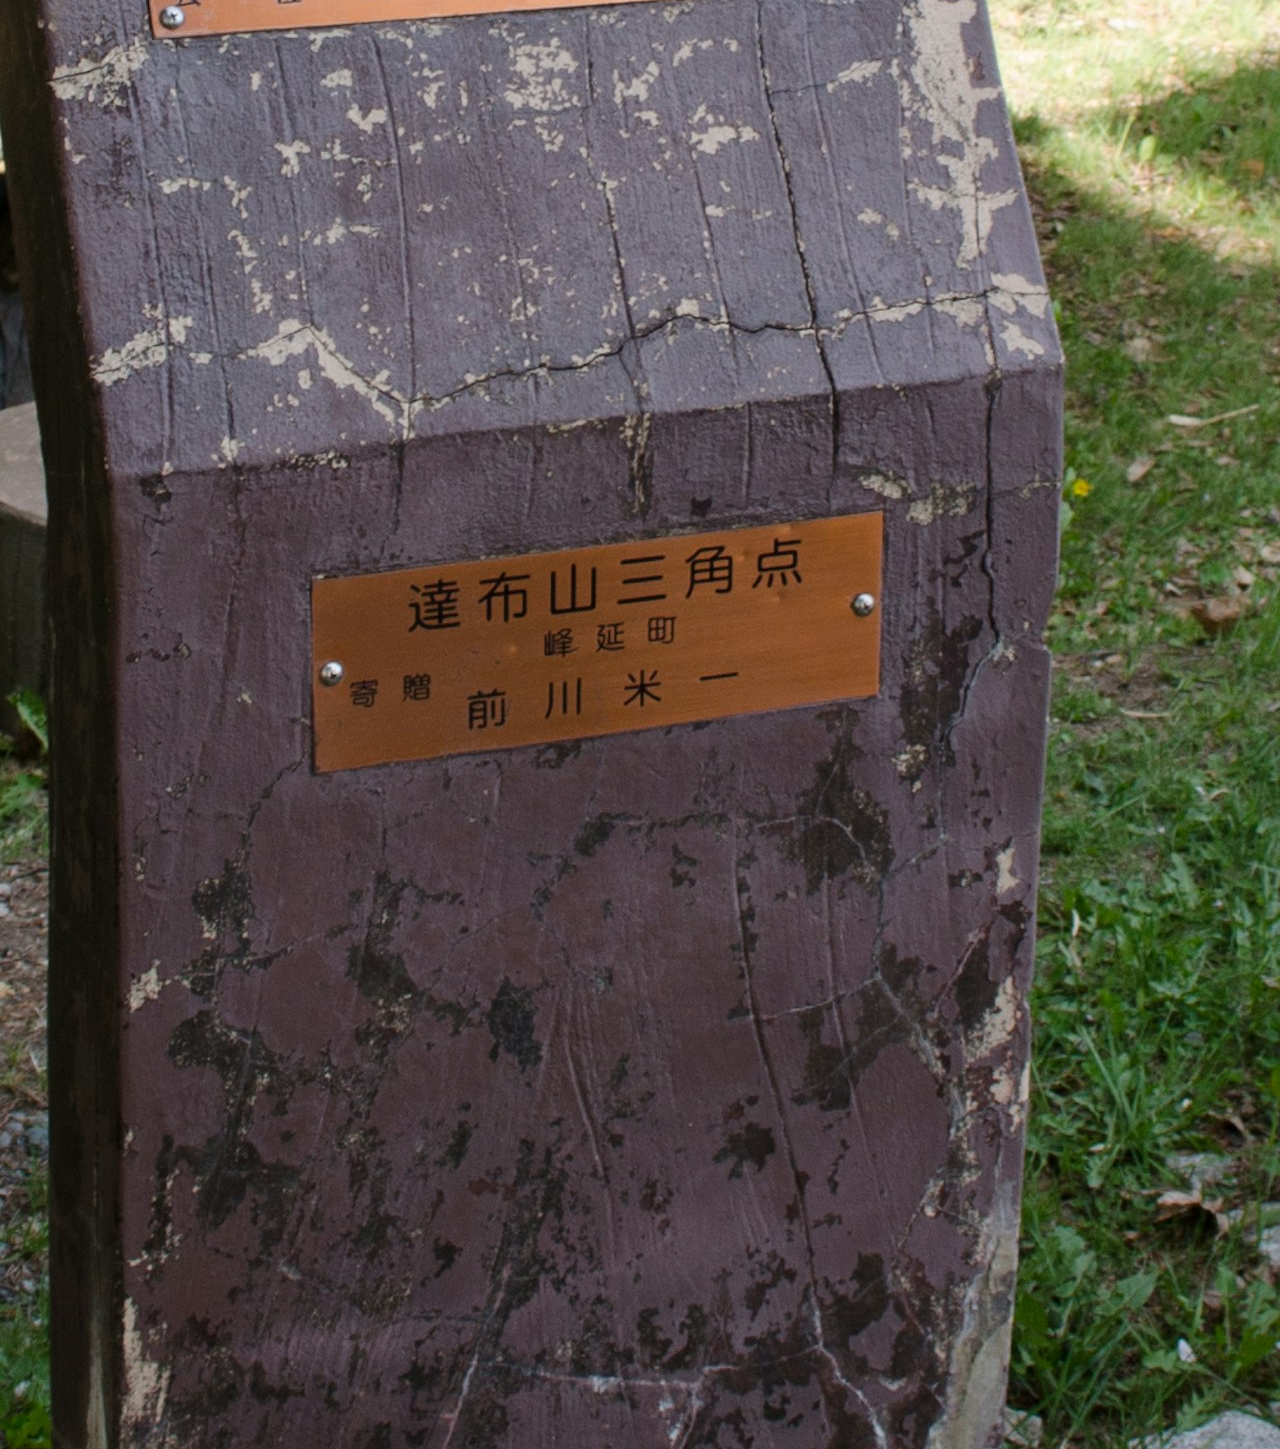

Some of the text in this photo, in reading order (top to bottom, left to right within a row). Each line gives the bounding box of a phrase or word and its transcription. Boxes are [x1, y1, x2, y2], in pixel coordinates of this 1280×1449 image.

[407, 538, 803, 633] 達布山三角点
[542, 616, 677, 658] 峰延町
[349, 669, 739, 731] 寄贈 前川米一
